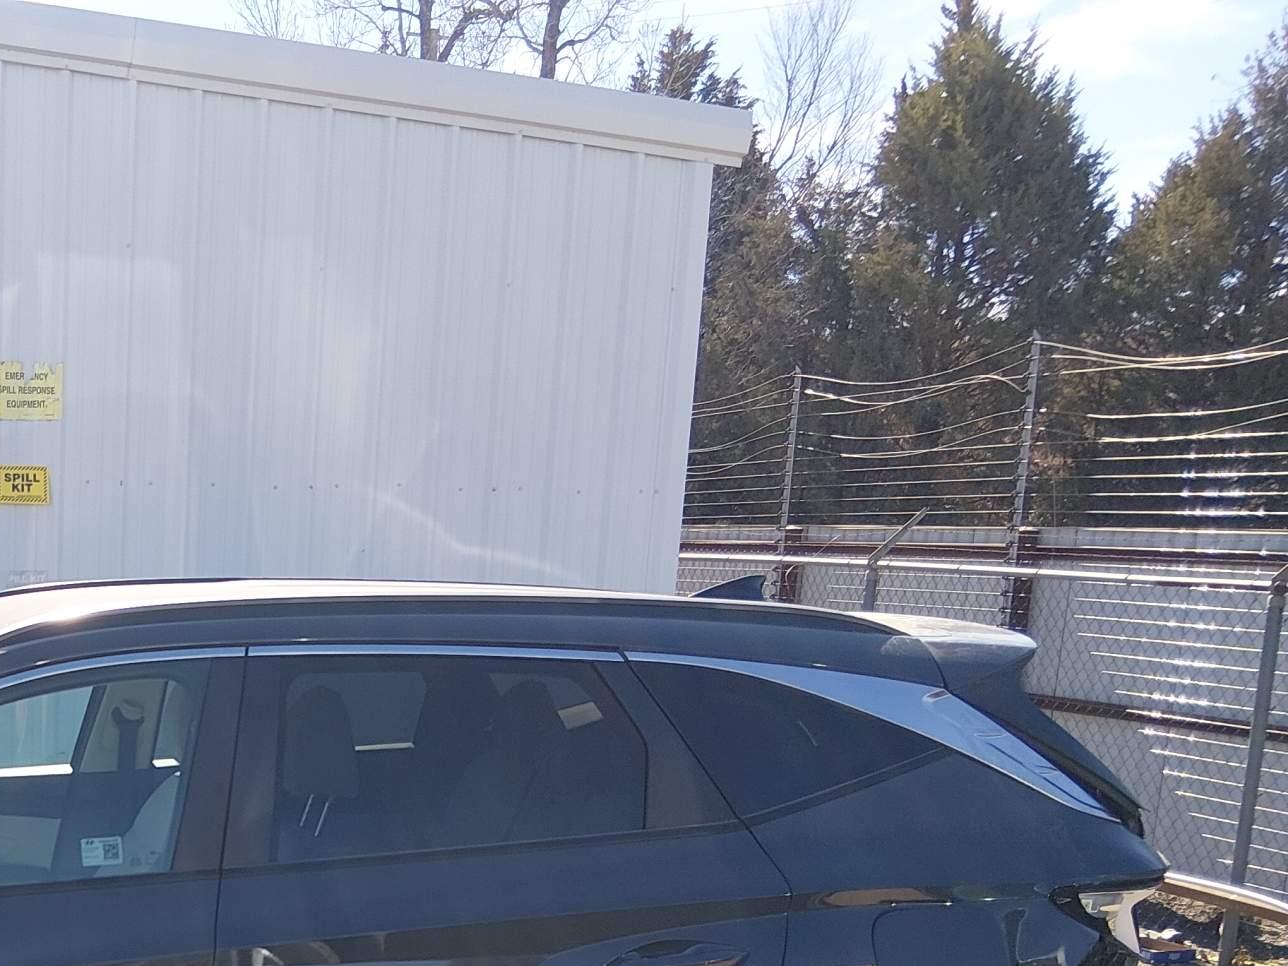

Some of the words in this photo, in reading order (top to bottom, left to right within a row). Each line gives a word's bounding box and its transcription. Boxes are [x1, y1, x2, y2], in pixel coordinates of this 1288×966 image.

[4, 371, 49, 381] EMERNCY
[18, 386, 56, 395] RESPONSE
[4, 472, 40, 483] SPILL
[11, 483, 33, 493] KIT
